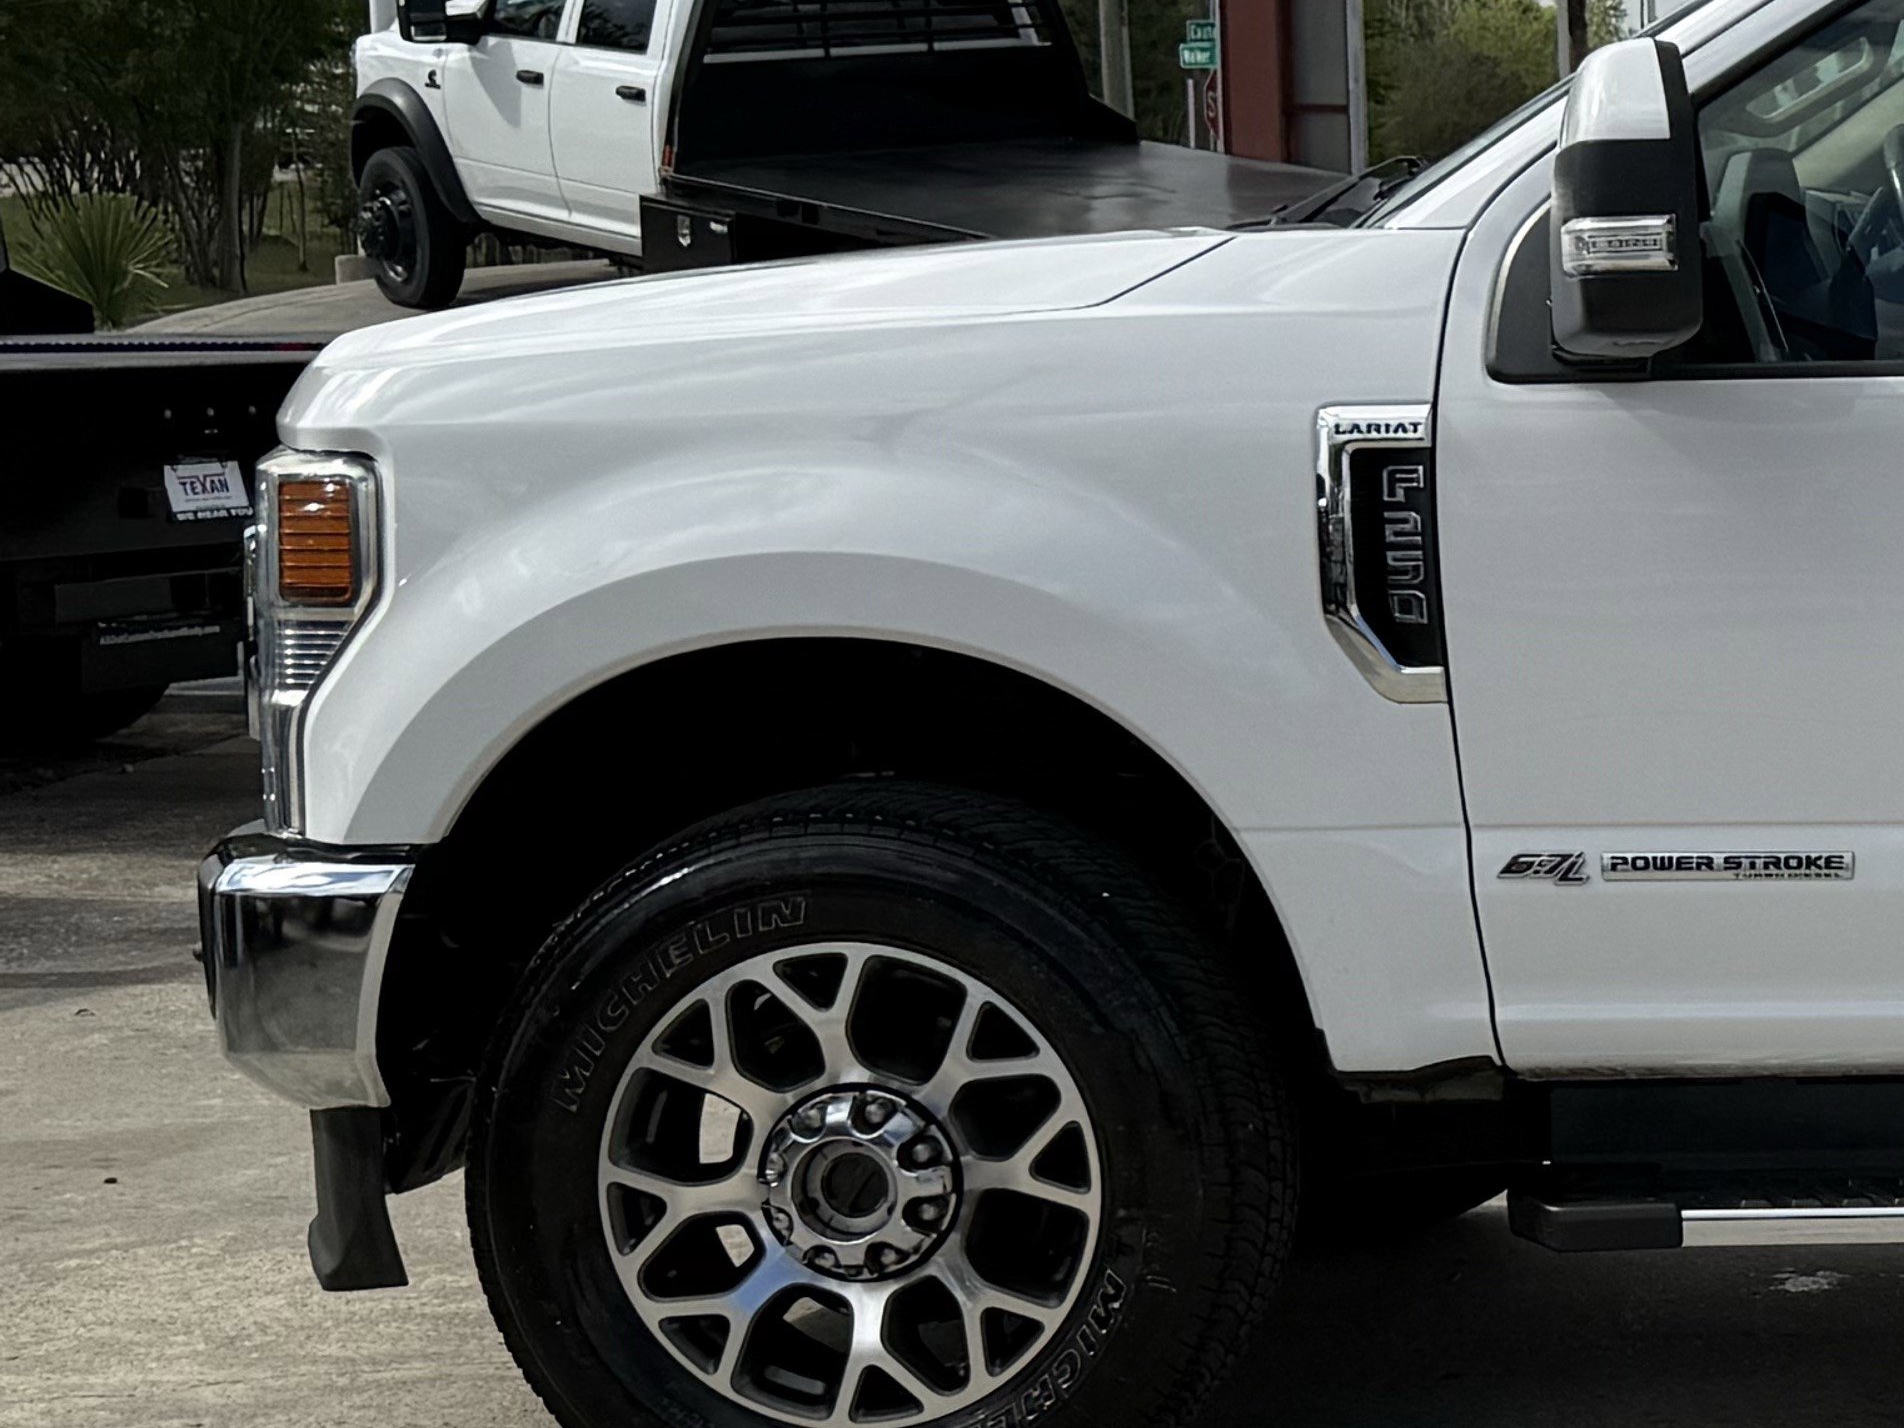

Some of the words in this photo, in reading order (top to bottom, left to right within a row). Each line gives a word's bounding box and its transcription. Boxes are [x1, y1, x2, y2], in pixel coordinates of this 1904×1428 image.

[1334, 421, 1424, 436] LARIAT
[177, 474, 230, 497] TEXAN
[1609, 854, 1715, 872] POWER
[1722, 854, 1845, 871] STROKE
[547, 895, 808, 1114] MICHELIN
